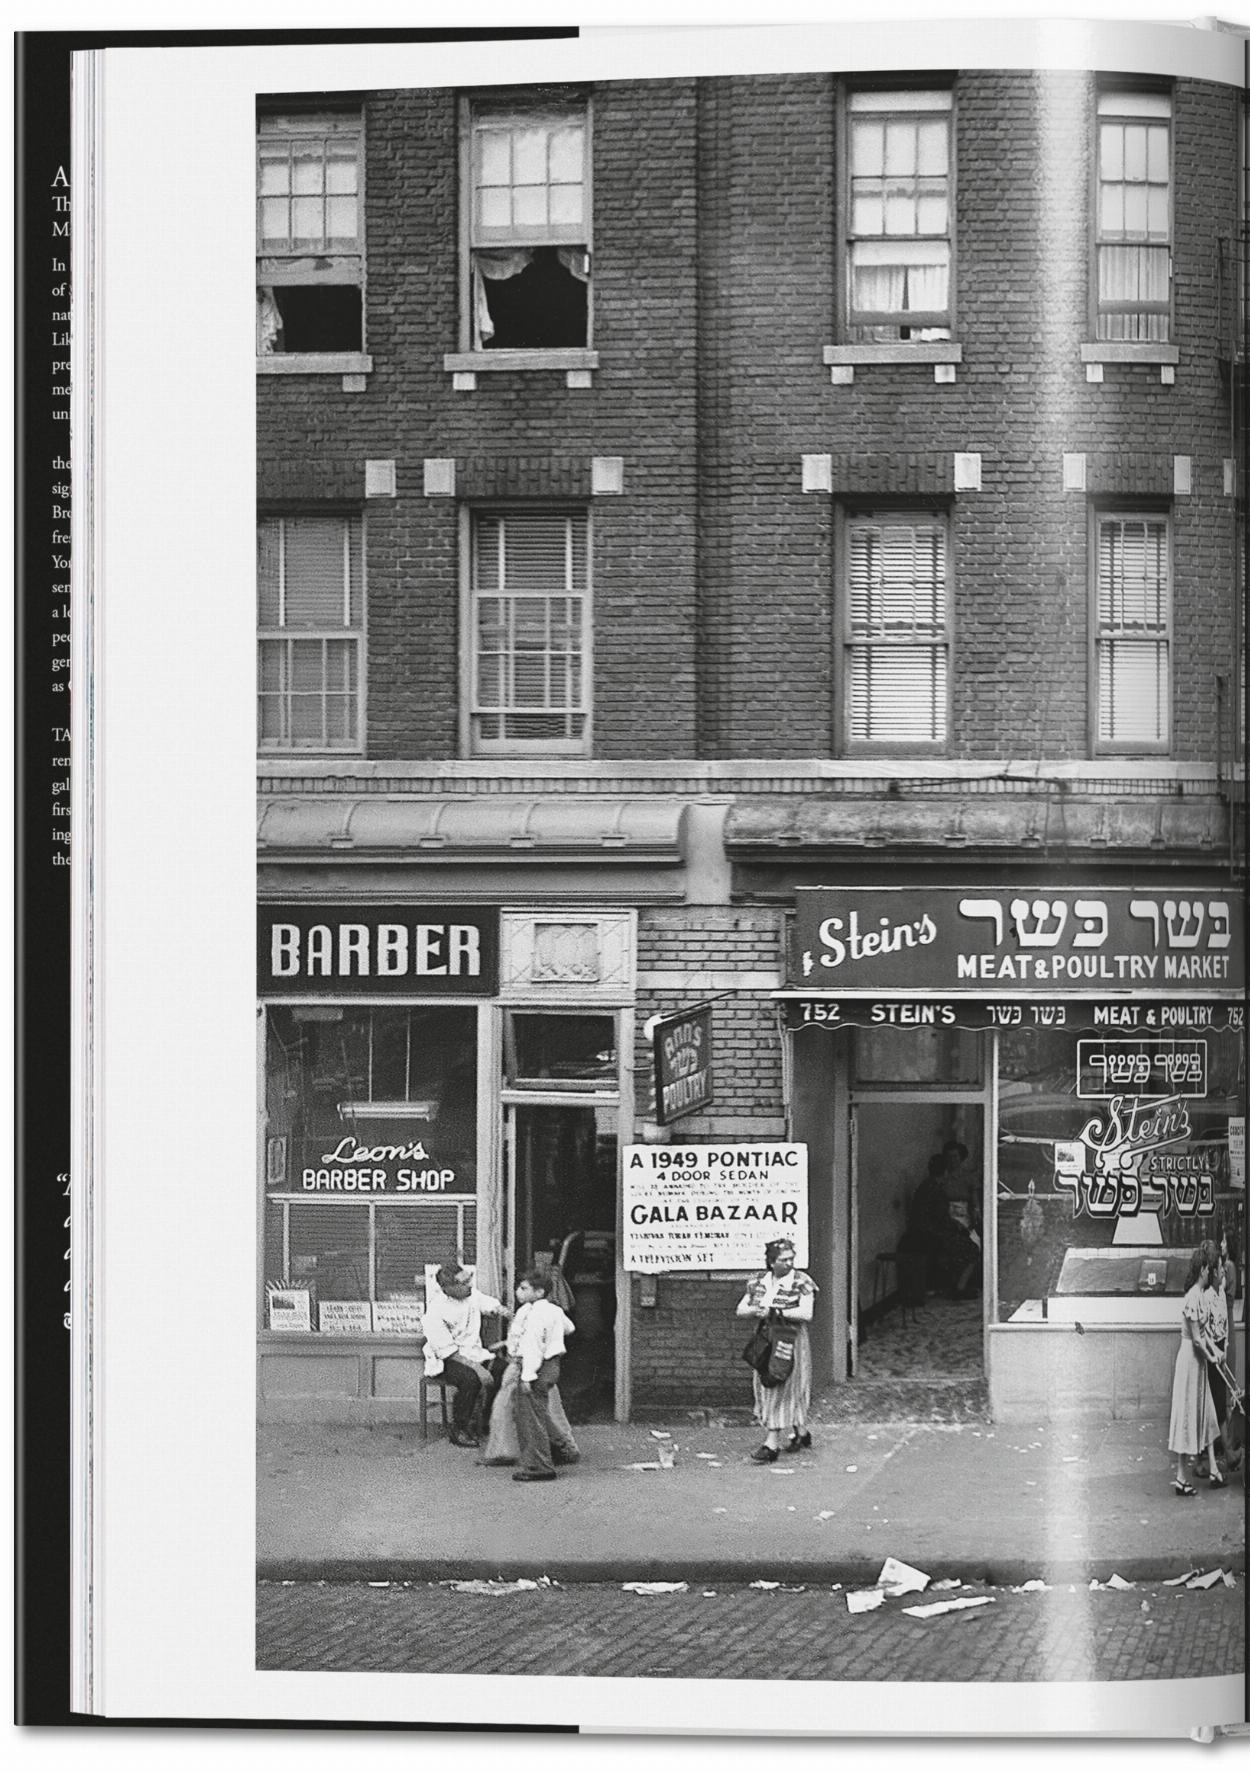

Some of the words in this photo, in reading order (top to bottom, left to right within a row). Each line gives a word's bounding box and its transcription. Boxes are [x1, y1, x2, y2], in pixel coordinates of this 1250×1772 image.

[52, 221, 71, 236] M
[52, 258, 66, 271] In
[52, 282, 67, 296] of
[52, 411, 71, 420] un
[52, 609, 59, 618] a
[52, 682, 64, 692] as
[52, 777, 70, 795] gal
[818, 911, 938, 967] Stein's
[271, 924, 480, 976] BARBER
[1164, 955, 1230, 979] MARKET
[801, 1003, 840, 1022] 752
[871, 1004, 956, 1024] STEIN'S
[1094, 1006, 1140, 1025] MEAT
[1145, 1009, 1156, 1026] &
[1161, 1006, 1213, 1026] POULTRY
[1227, 1007, 1244, 1026] 752
[1077, 1094, 1193, 1169] Stein's
[321, 1136, 430, 1164] Leon's
[630, 1152, 644, 1169] A
[651, 1151, 698, 1169] 1949
[707, 1150, 799, 1168] PONTIAC
[1150, 1155, 1205, 1171] STRICTLY
[302, 1168, 386, 1191] BARBER
[396, 1168, 455, 1191] SHOP
[656, 1171, 667, 1181] 4
[671, 1170, 711, 1182] DOOR
[719, 1169, 769, 1181] SEDAN
[630, 1203, 689, 1225] GALA
[696, 1201, 798, 1225] BAZAAR
